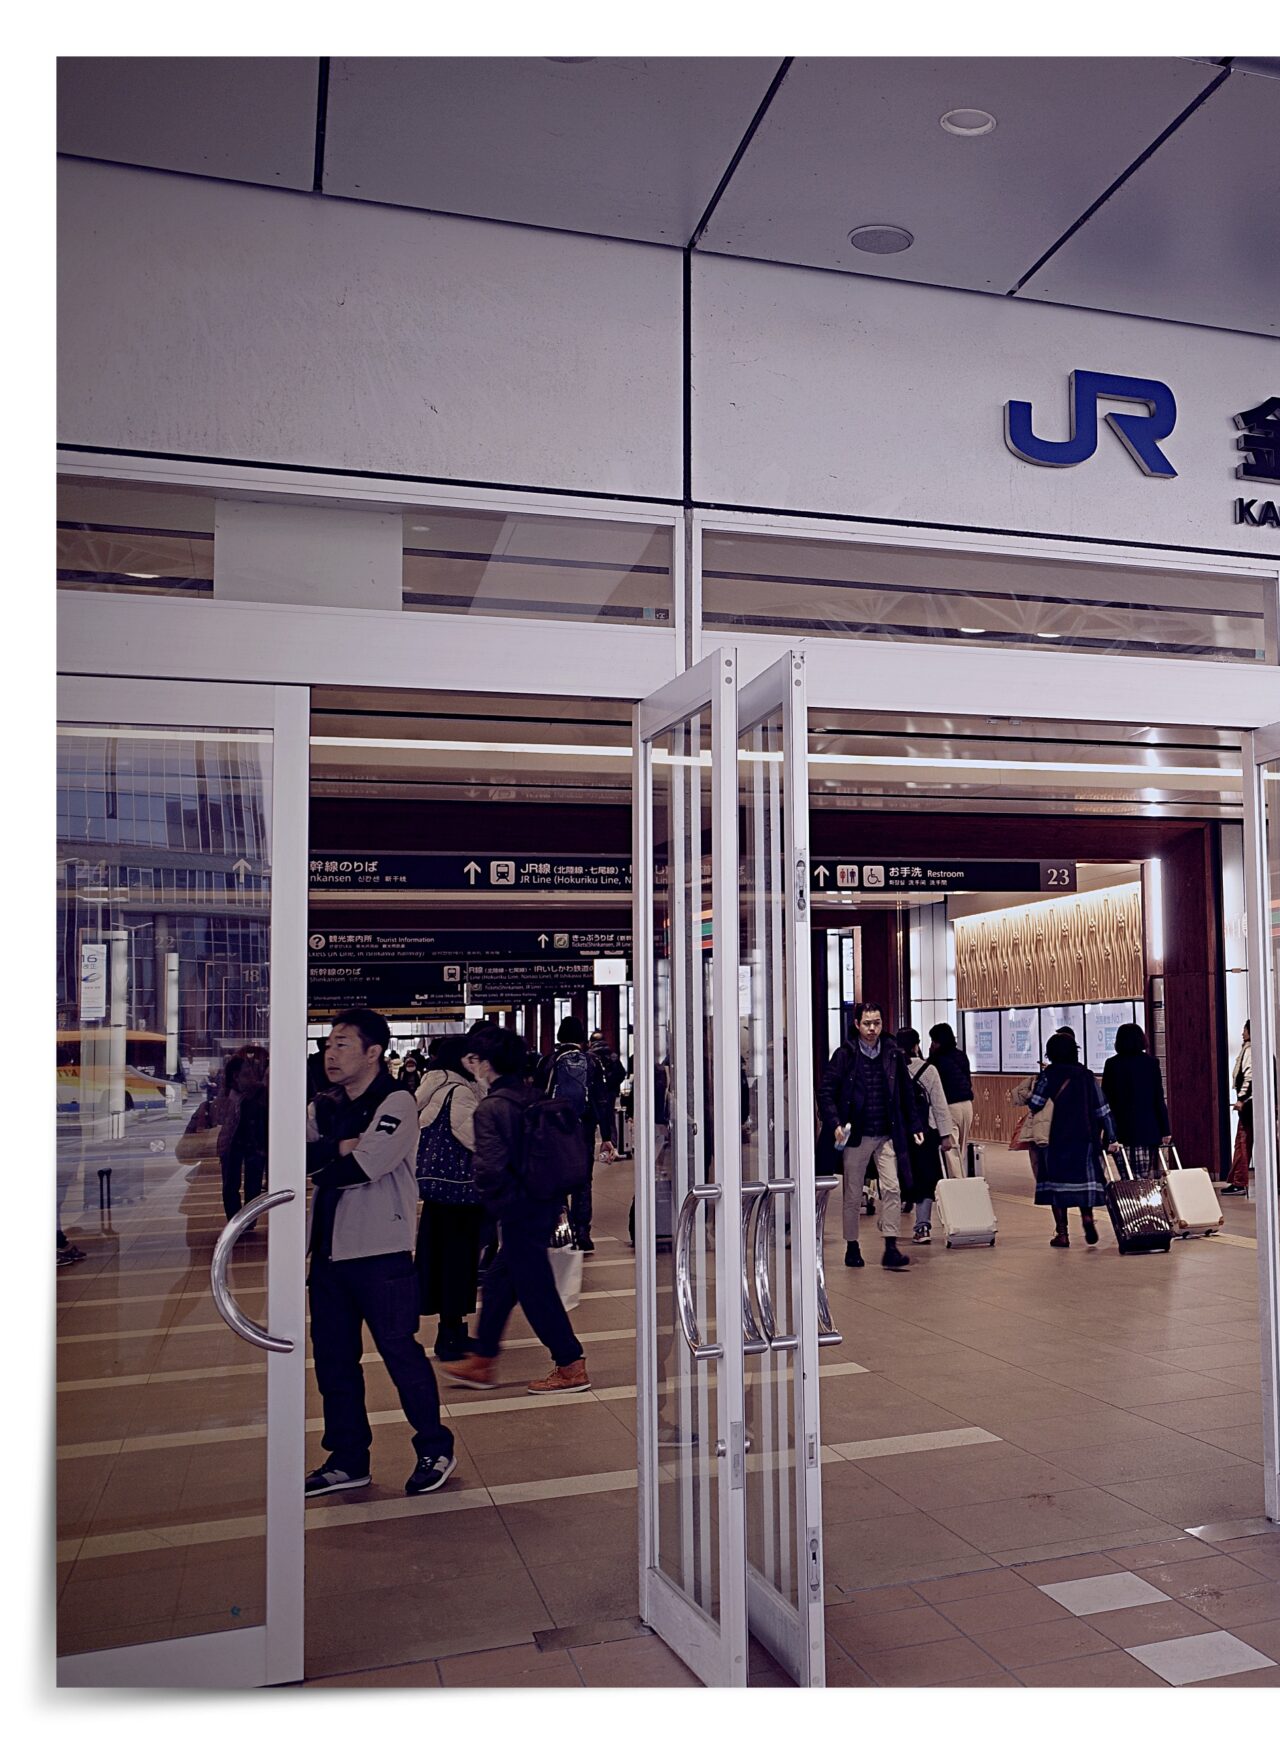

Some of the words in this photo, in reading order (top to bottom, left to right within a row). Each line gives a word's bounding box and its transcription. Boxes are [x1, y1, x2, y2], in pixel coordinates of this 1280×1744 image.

[1004, 369, 1178, 480] JR
[310, 873, 351, 883] nkansen
[888, 866, 923, 878] お手洗
[927, 869, 965, 878] Restroom
[1047, 868, 1070, 885] 23
[519, 876, 530, 884] JR
[532, 876, 552, 884] Line
[553, 875, 598, 885] (Hokuriku
[600, 876, 622, 885] Line,
[242, 969, 260, 983] 18
